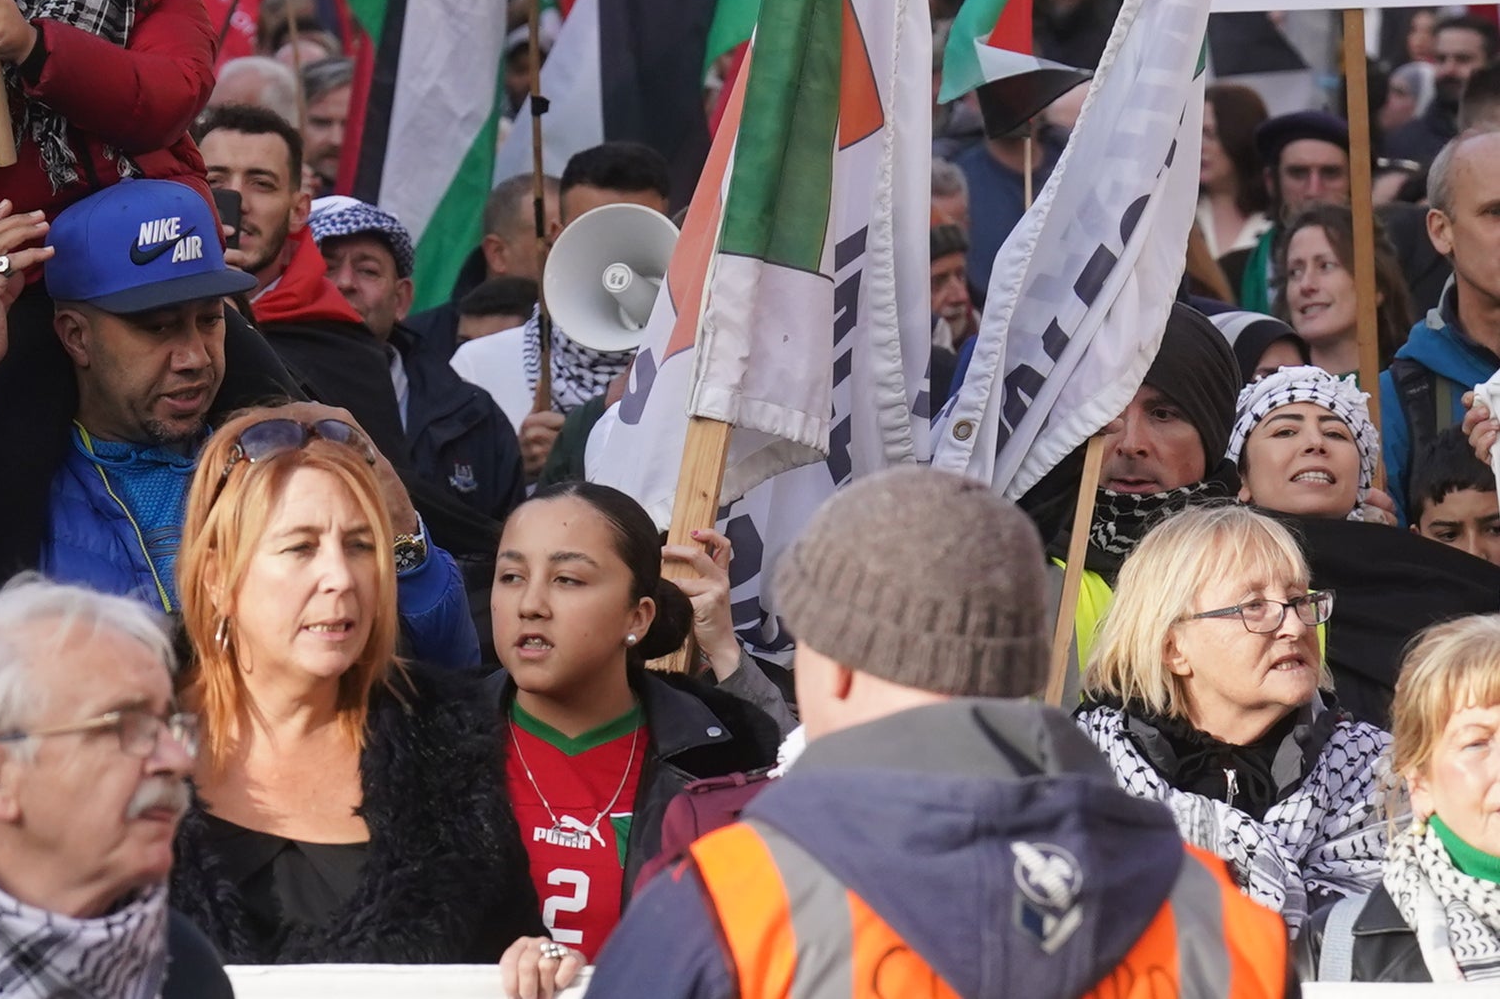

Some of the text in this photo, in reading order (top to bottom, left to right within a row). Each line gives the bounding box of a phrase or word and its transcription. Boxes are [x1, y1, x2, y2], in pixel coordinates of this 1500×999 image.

[138, 216, 181, 247] NIKE
[171, 235, 203, 263] AIR
[532, 825, 592, 850] PUMA
[542, 867, 591, 944] 2
